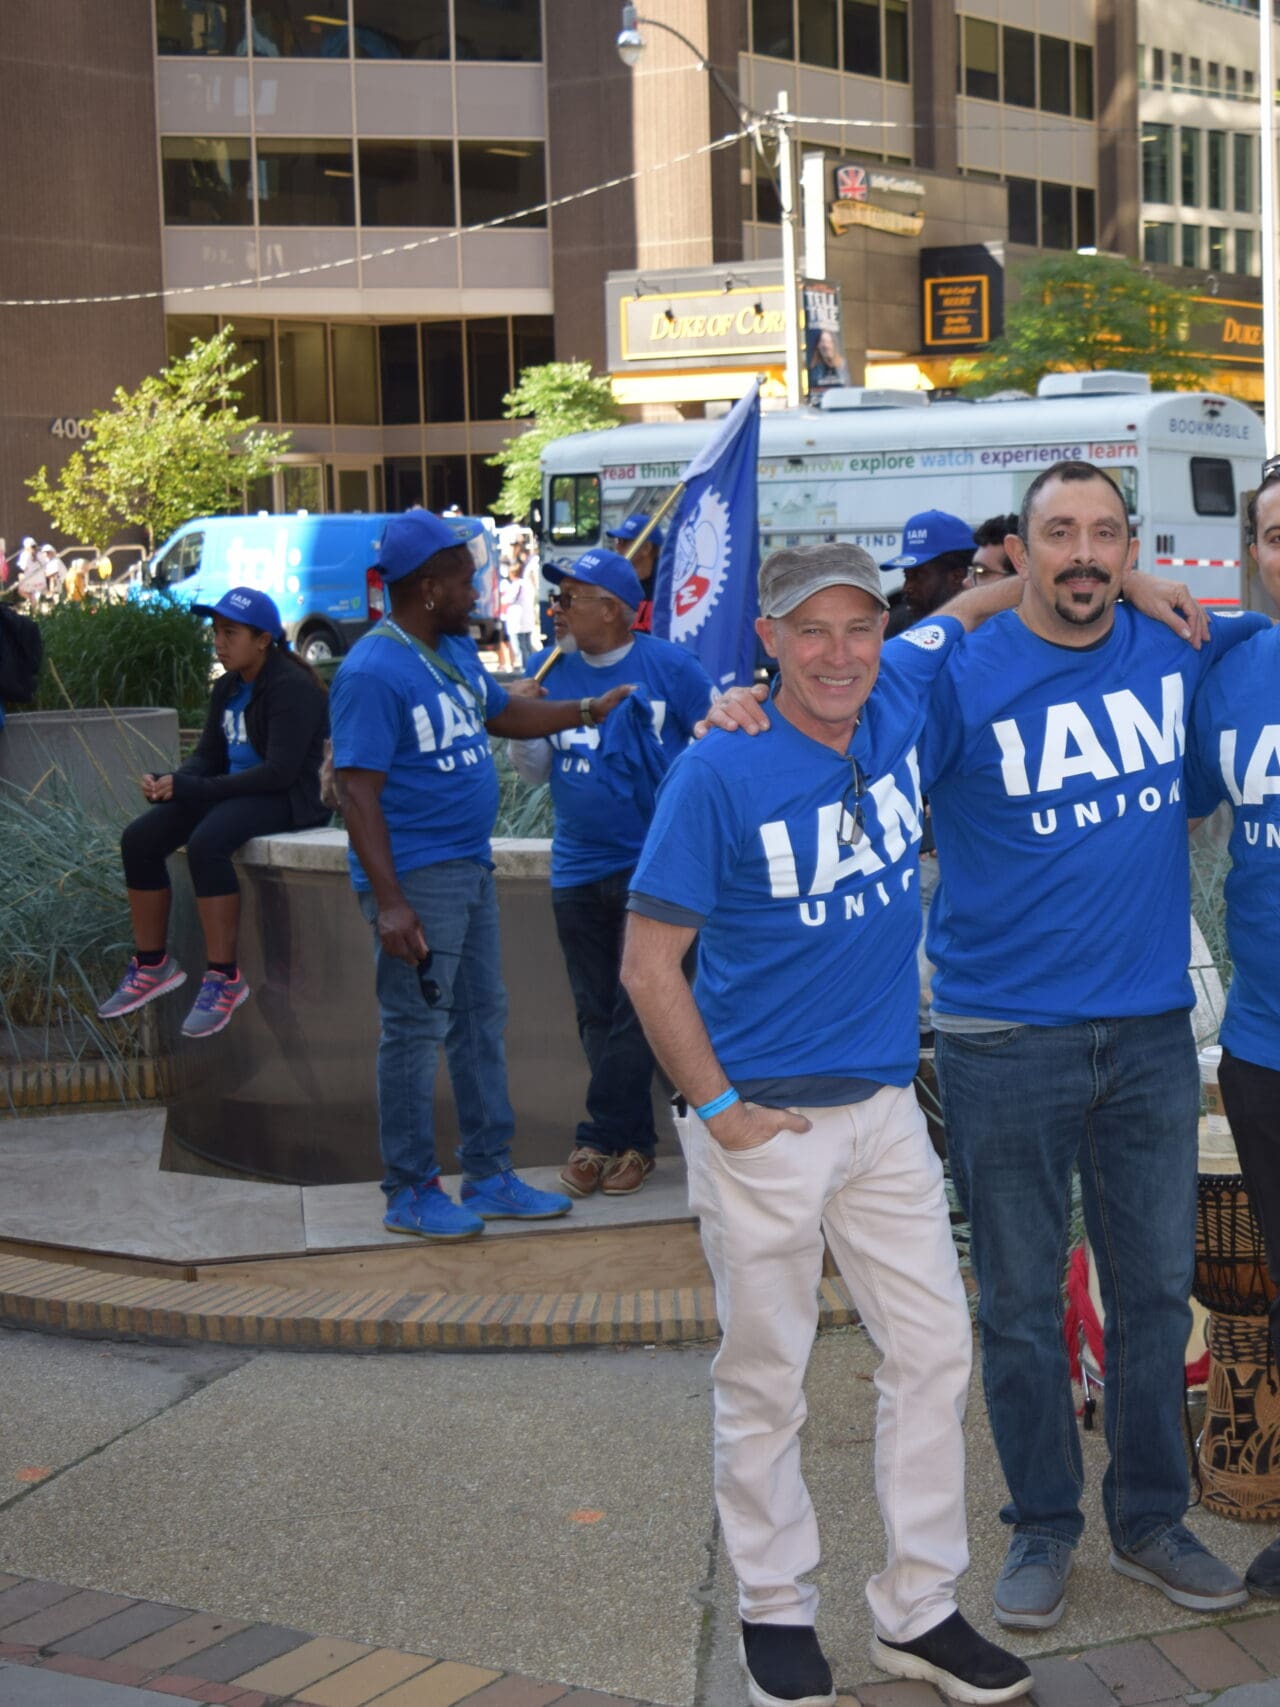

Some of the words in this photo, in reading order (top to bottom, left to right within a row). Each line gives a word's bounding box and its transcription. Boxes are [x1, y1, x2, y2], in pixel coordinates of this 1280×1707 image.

[51, 418, 90, 439] 400
[1169, 418, 1249, 440] BOOKMOBILE
[602, 463, 636, 480] read
[641, 462, 680, 479] think
[850, 451, 915, 474] explore
[920, 449, 974, 468] watch
[980, 445, 1082, 467] experience
[1087, 442, 1138, 459] learn
[855, 534, 897, 547] FIND
[906, 528, 929, 540] IAM
[992, 672, 1186, 796] IAM
[760, 746, 923, 898] IAM
